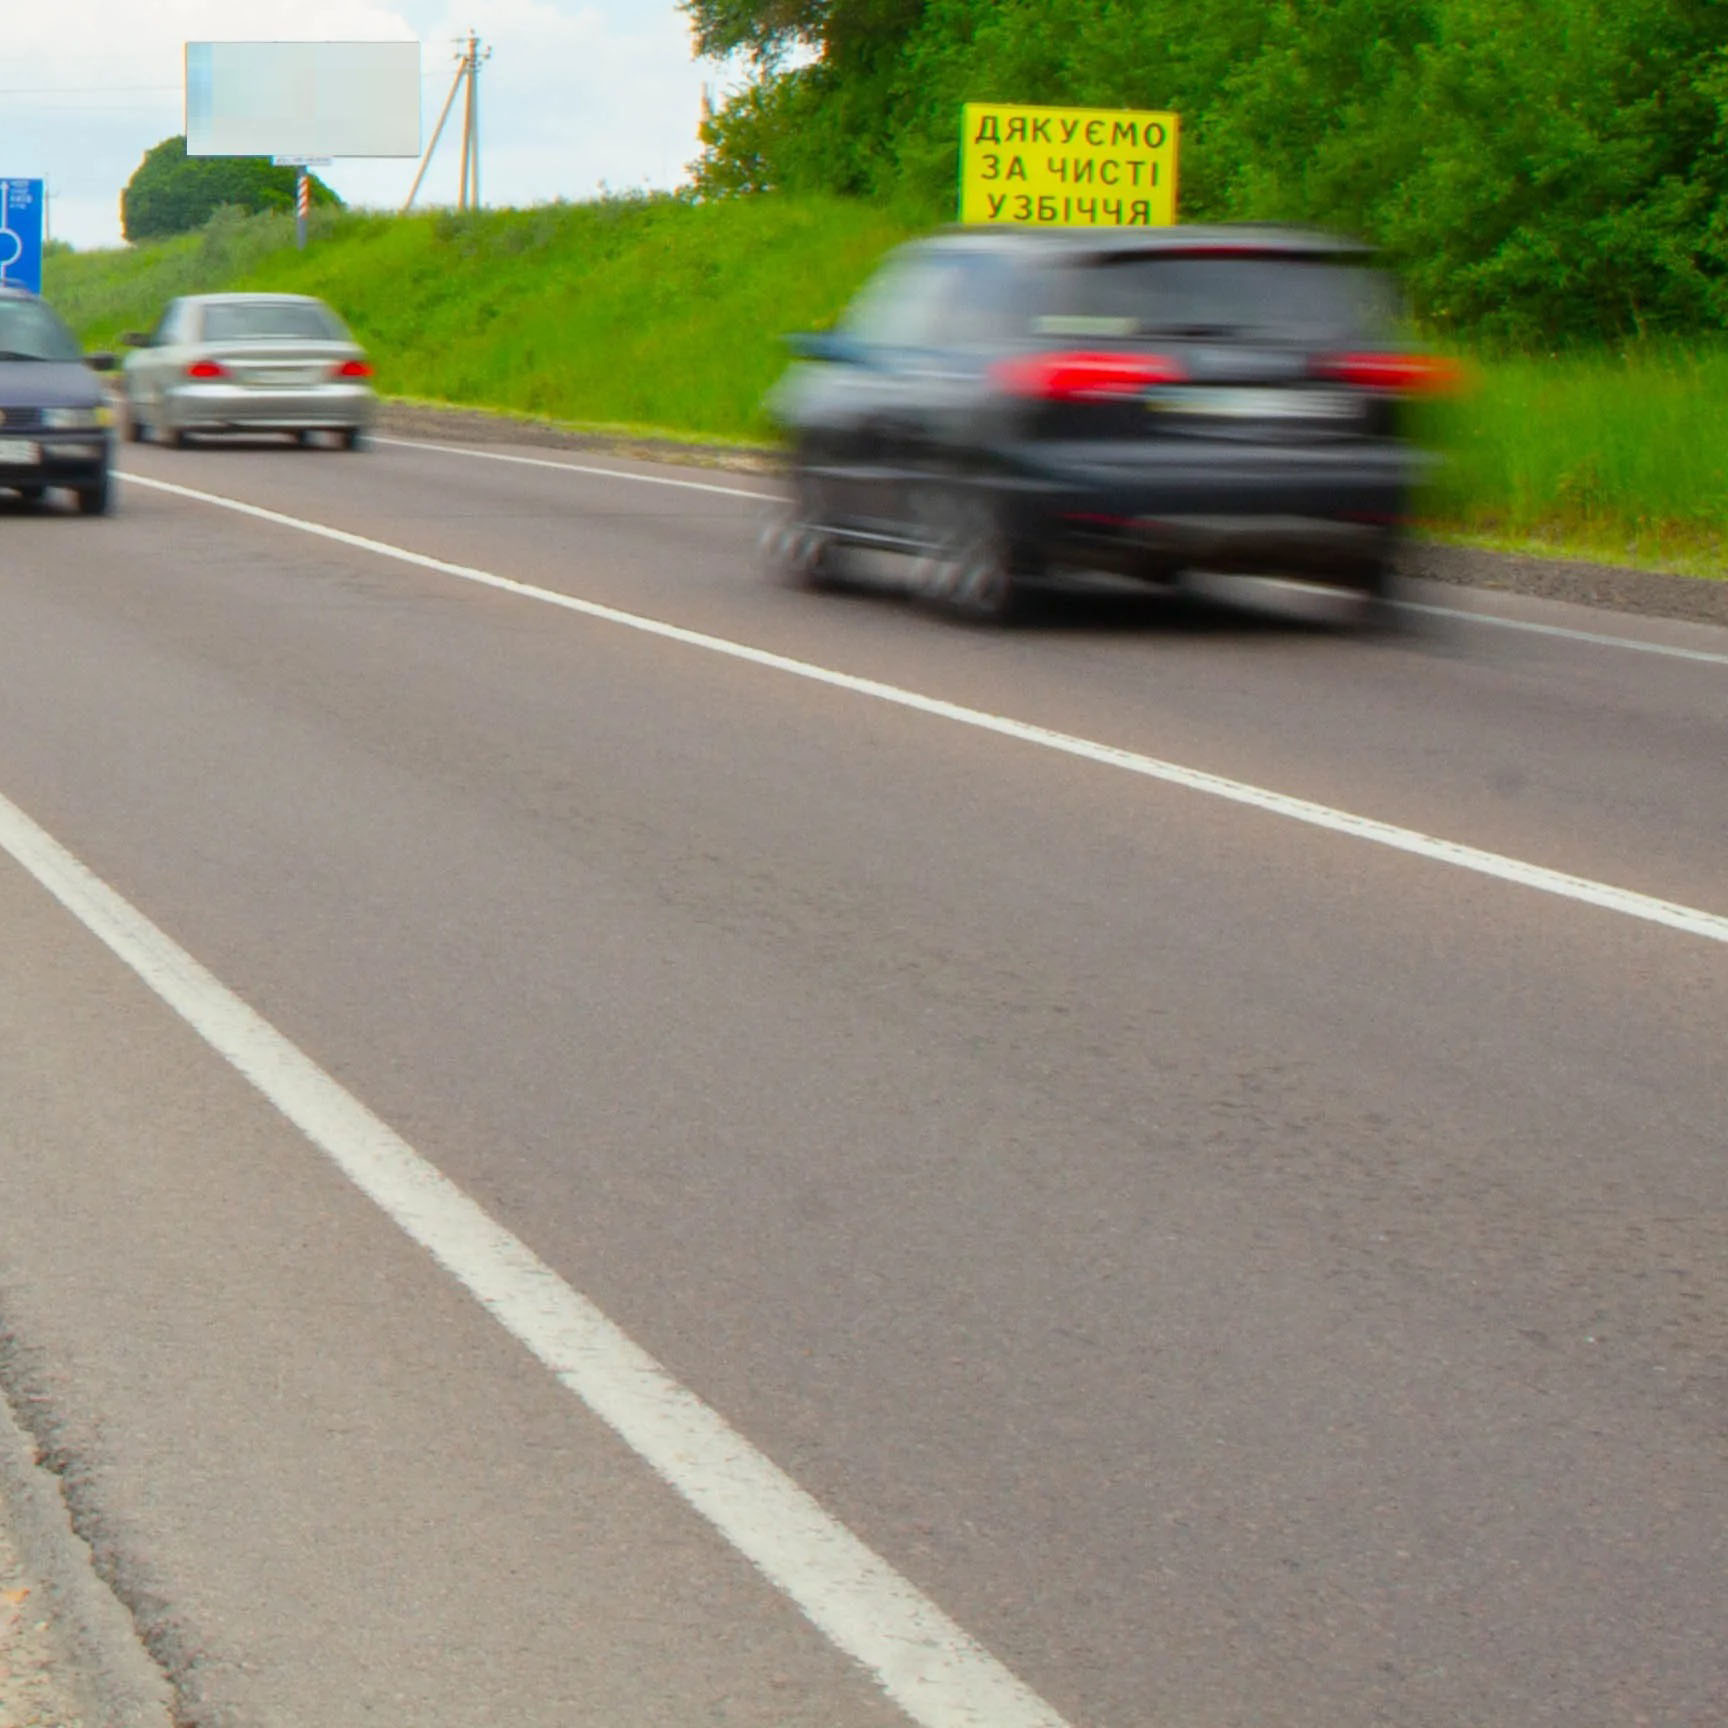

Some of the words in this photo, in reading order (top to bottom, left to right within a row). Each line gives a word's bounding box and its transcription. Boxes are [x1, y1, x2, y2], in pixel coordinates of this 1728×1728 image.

[975, 114, 1167, 149] ДЯКУЄМО
[980, 154, 1027, 182] ЗА
[1047, 156, 1159, 188] ЧИСТІ
[987, 193, 1150, 225] УЗБІЧЧЯ
